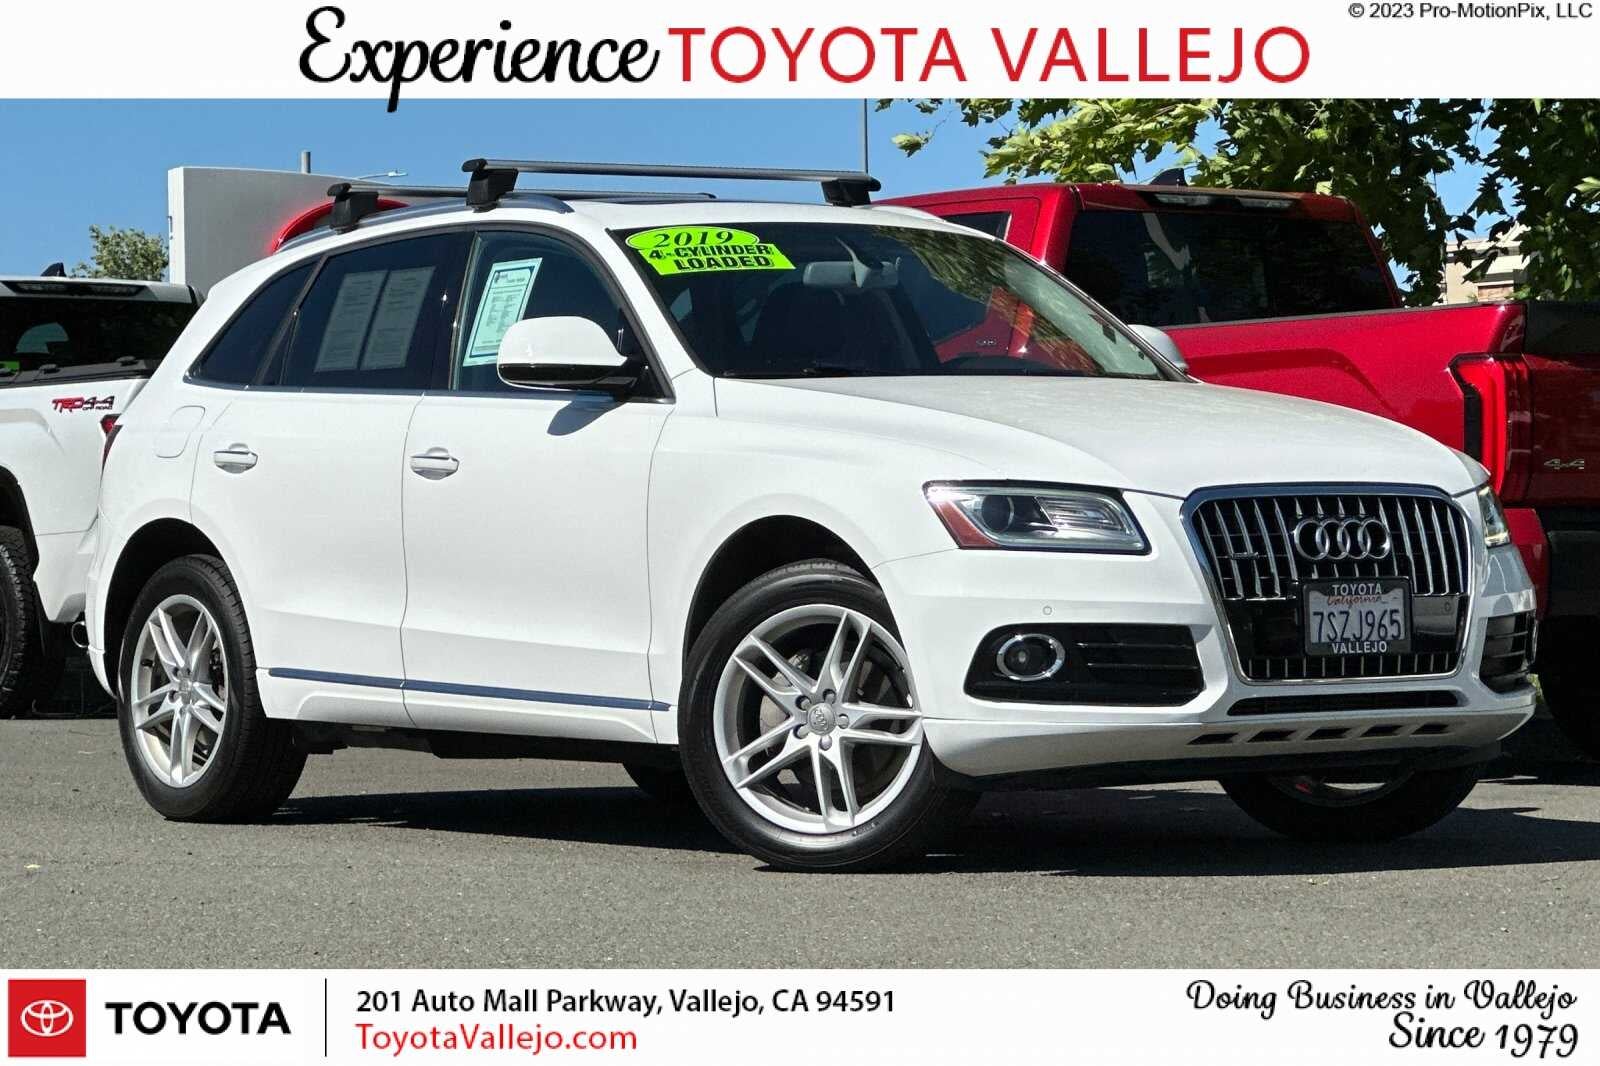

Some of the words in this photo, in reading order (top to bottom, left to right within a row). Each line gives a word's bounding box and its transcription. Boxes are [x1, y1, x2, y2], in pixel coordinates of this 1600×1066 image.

[654, 231, 734, 248] 2019
[650, 245, 773, 260] 4-CYLINDER
[674, 256, 772, 271] LOADED
[1332, 584, 1382, 596] TOYOTA
[1313, 608, 1401, 641] 7SZJ965
[1332, 641, 1388, 654] VALLEJO
